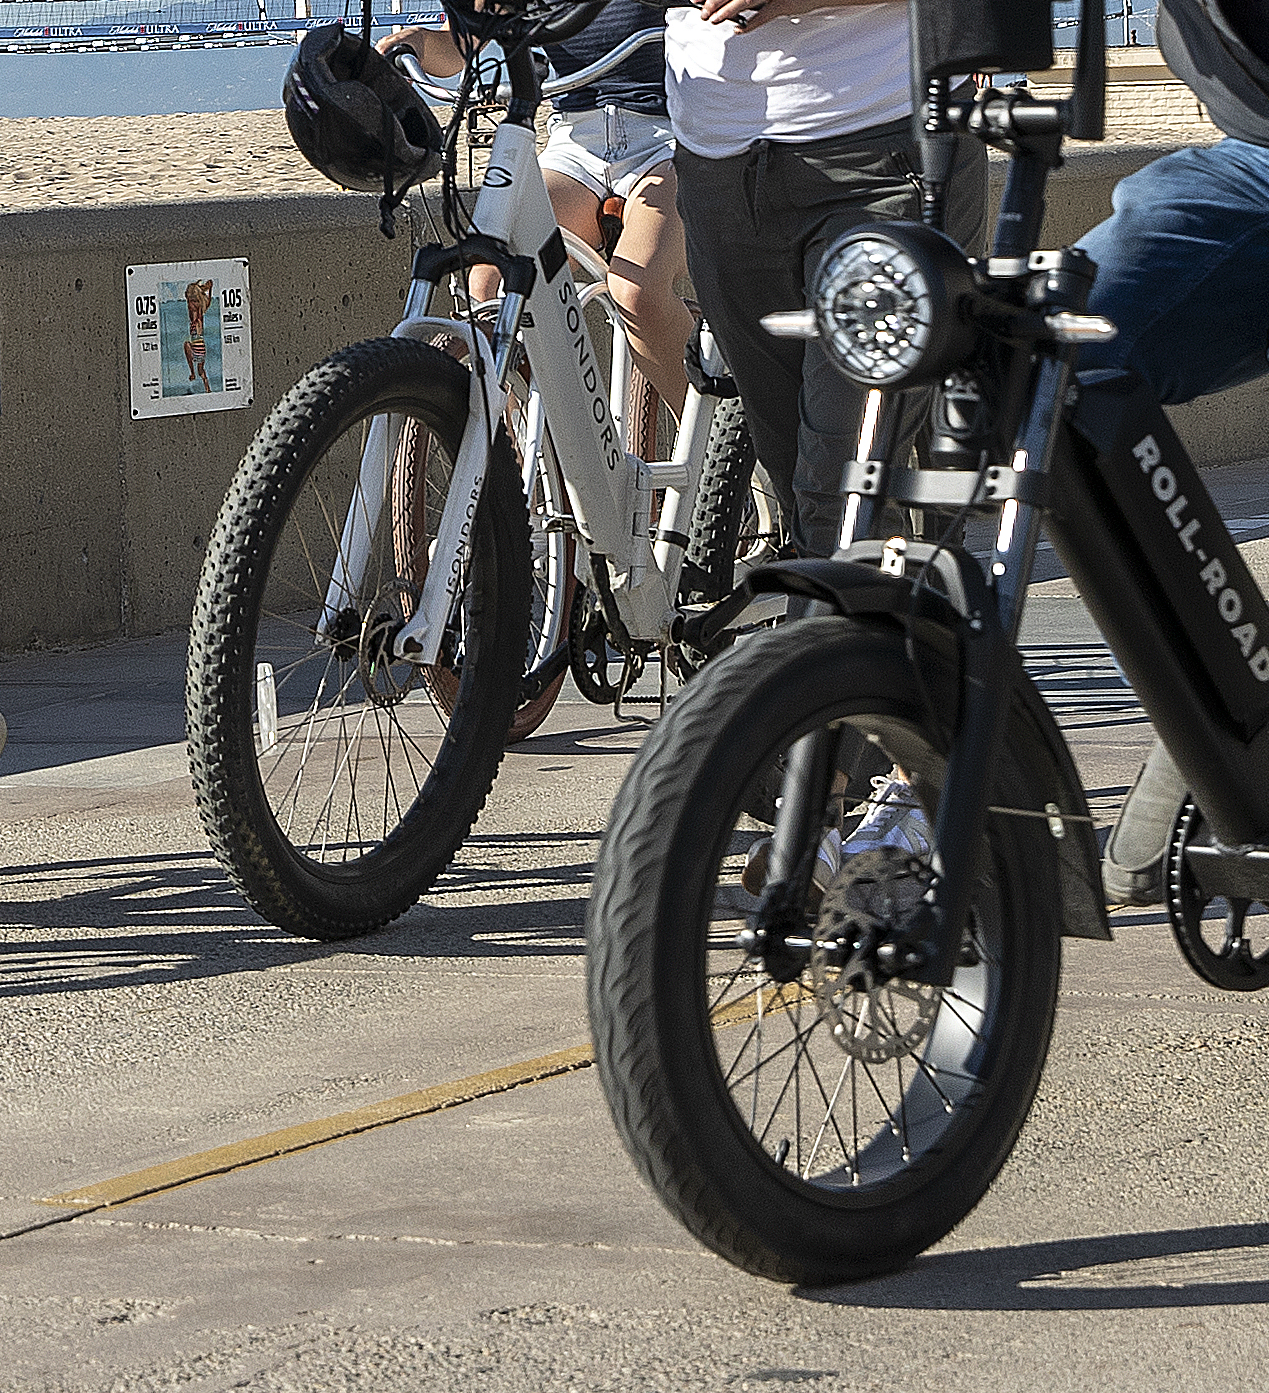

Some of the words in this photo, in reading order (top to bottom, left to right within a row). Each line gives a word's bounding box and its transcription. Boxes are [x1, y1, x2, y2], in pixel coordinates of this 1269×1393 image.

[243, 21, 278, 31] ULTRA
[344, 16, 379, 27] ULTA
[49, 27, 83, 37] ULTRA
[146, 24, 180, 34] ULTRA
[222, 289, 241, 307] 1.05
[136, 296, 157, 315] 0.75
[559, 282, 619, 471] SONDORS
